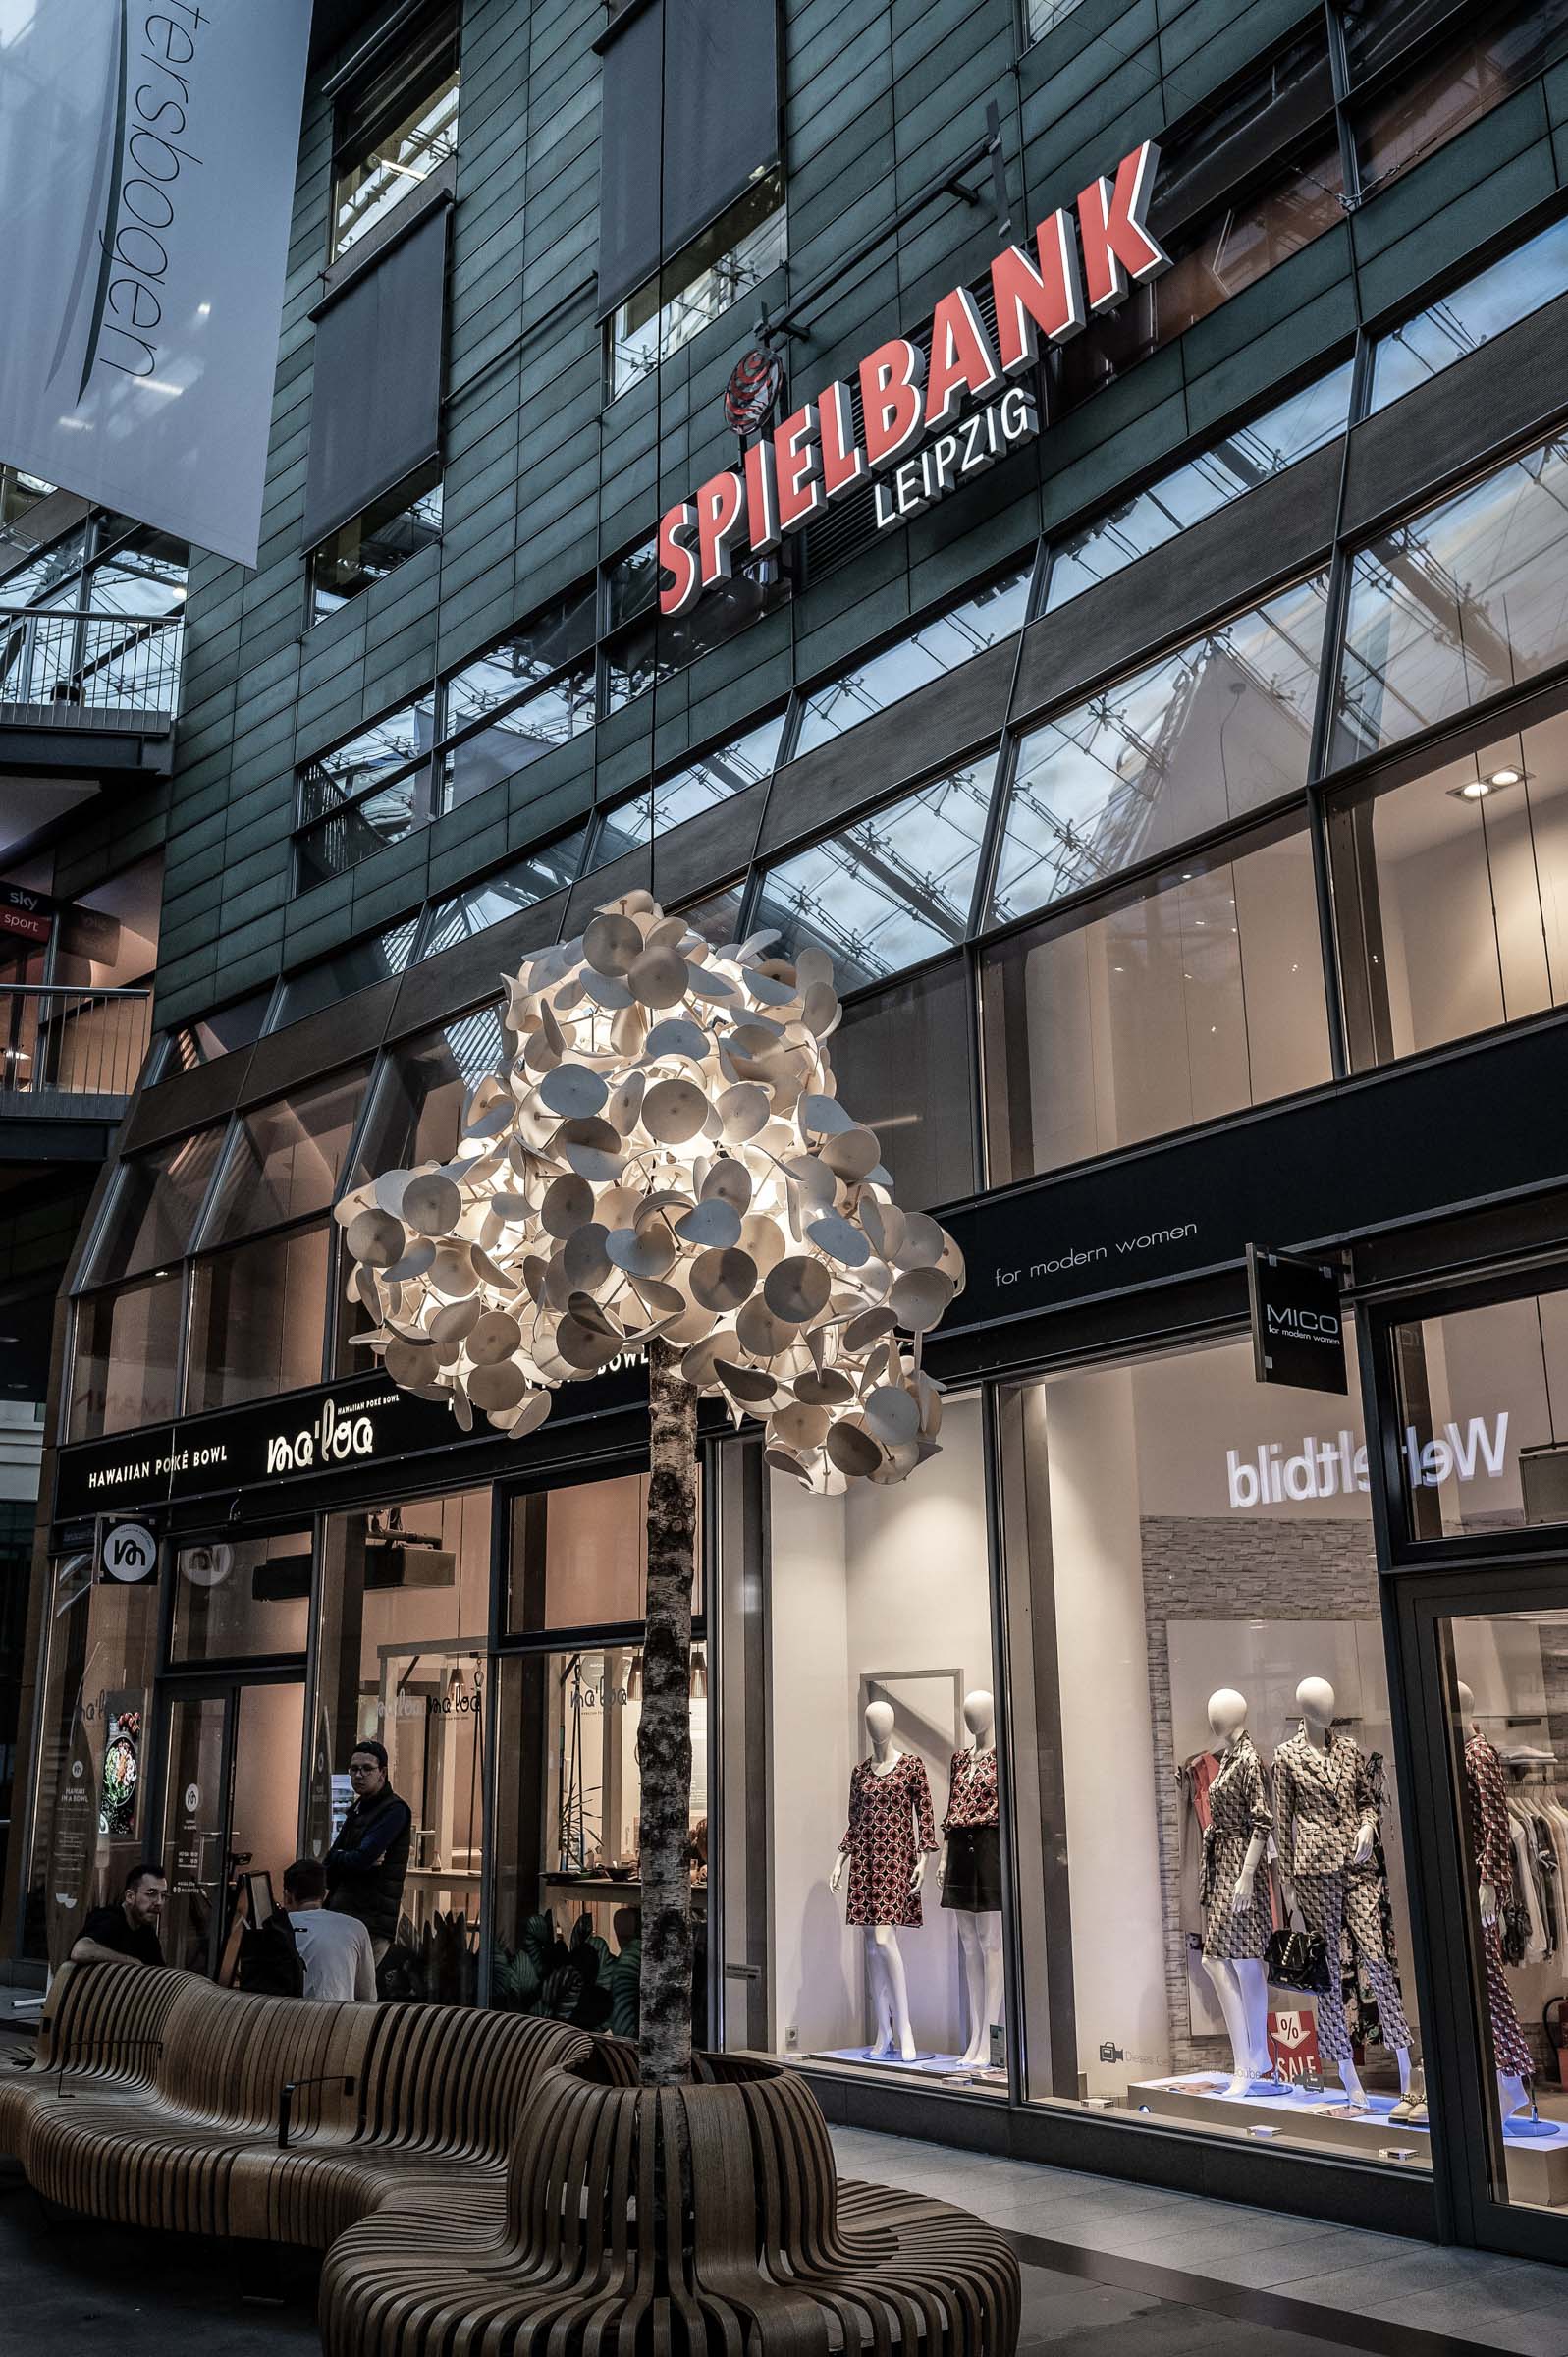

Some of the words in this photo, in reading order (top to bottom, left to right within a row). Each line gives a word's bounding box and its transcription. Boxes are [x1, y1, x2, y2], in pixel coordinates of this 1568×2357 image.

[659, 139, 1170, 618] SPIELBANK
[874, 387, 1037, 529] LEIPZIG
[9, 892, 37, 910] sky
[3, 913, 40, 932] sport
[996, 1268, 1022, 1287] for
[1030, 1247, 1108, 1278] modern
[1115, 1223, 1198, 1254] women
[1266, 1303, 1339, 1335] MICO
[1268, 1324, 1280, 1334] for
[1281, 1329, 1312, 1341] modern
[1312, 1335, 1341, 1346] women
[337, 1401, 365, 1416] HAWAIIAN
[366, 1396, 382, 1409] POKÉ
[383, 1394, 400, 1405] BOWL
[89, 1461, 150, 1489] HAWAIIAN
[155, 1450, 189, 1475] POKÉ
[193, 1445, 228, 1467] BOWL
